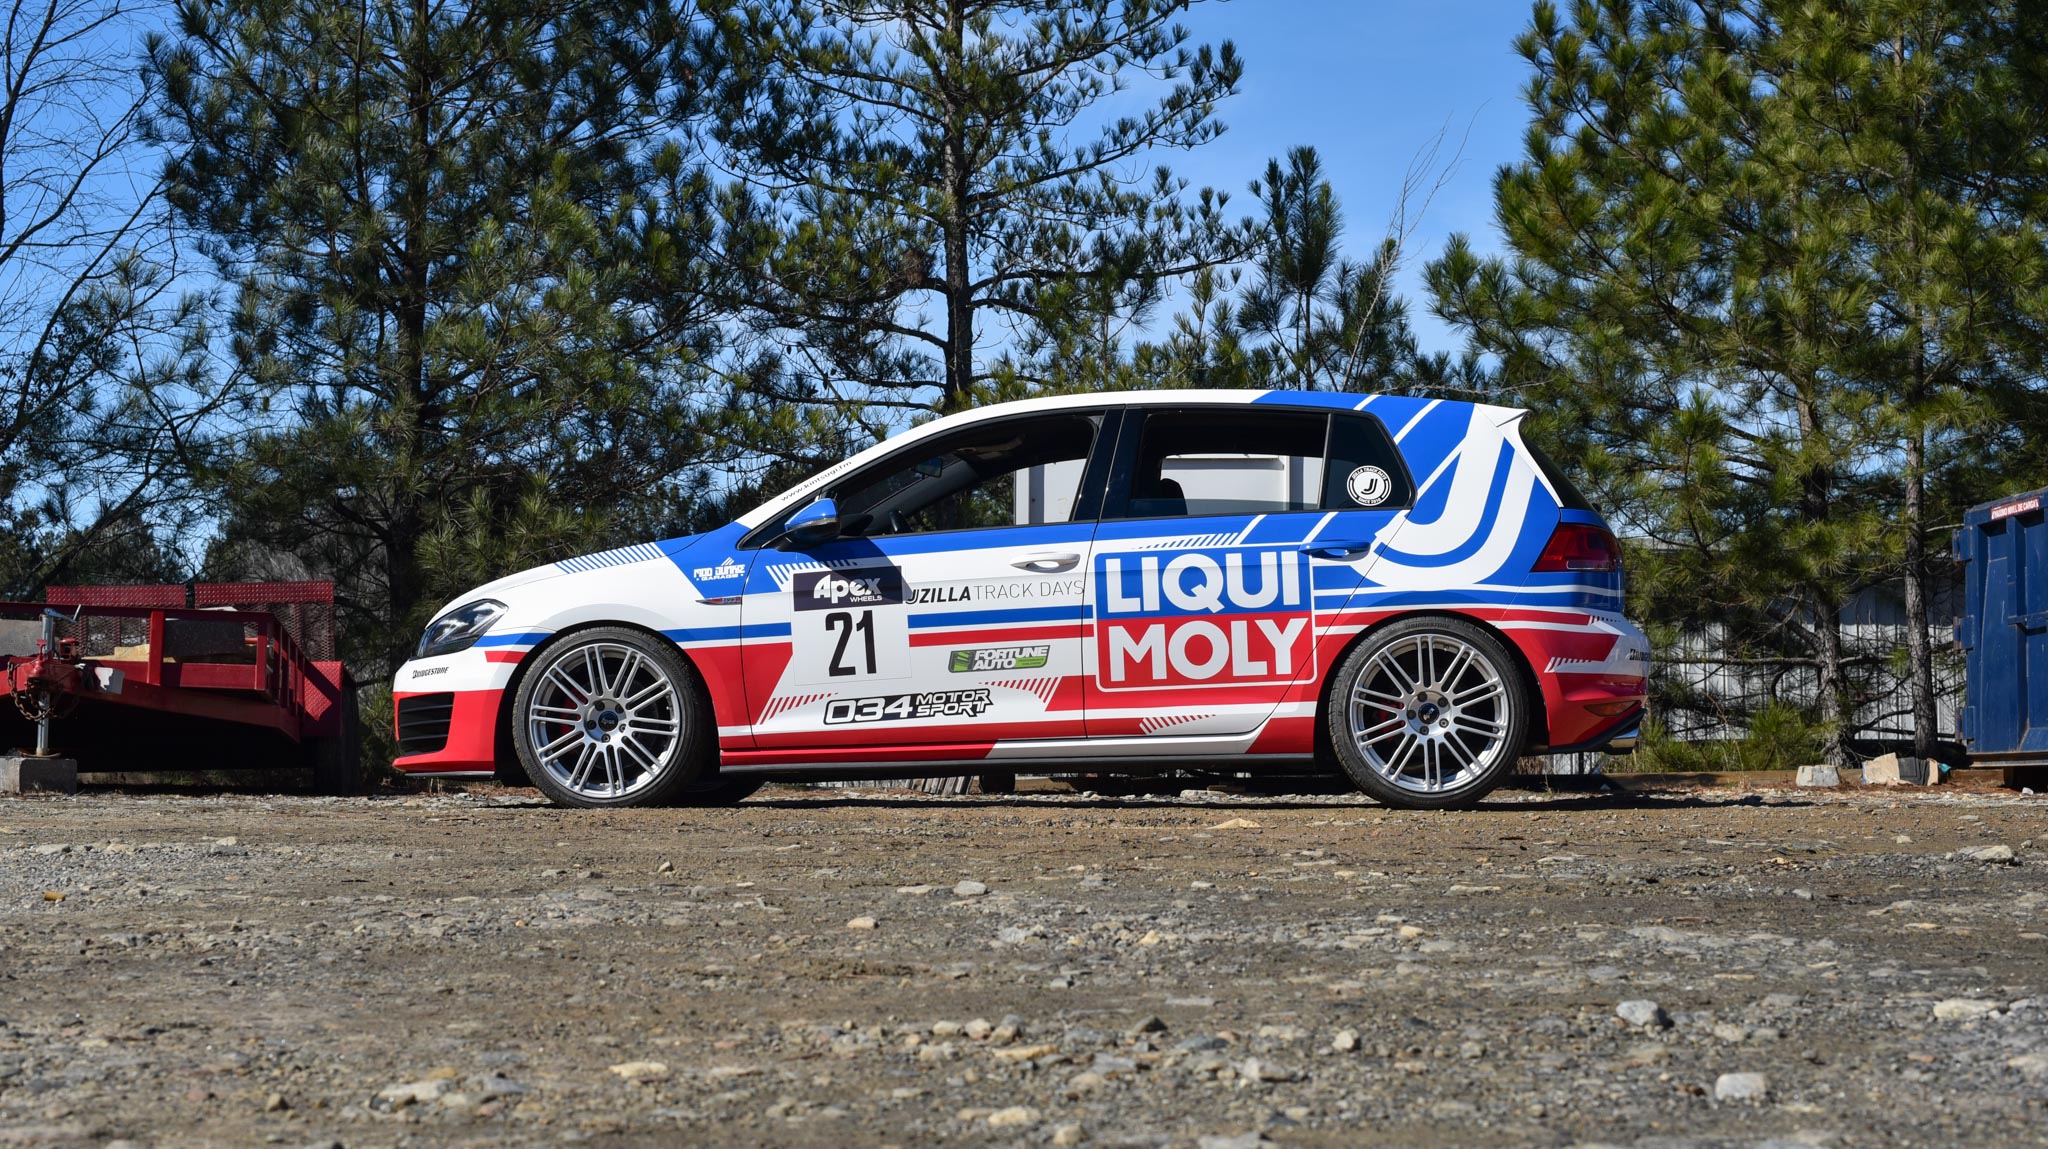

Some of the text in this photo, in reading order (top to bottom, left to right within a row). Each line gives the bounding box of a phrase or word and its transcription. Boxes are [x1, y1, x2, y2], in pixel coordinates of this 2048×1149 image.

[973, 582, 1034, 601] TRACK
[1040, 580, 1085, 597] DAYS
[1105, 550, 1301, 614] LIQUI
[850, 594, 882, 603] WHEELS
[825, 609, 877, 677] 21
[1108, 617, 1309, 682] MOLY
[974, 646, 1049, 661] FORTUNE
[972, 658, 1017, 671] AUTO
[916, 689, 989, 705] MOTOR
[825, 695, 913, 724] 034
[916, 701, 988, 717] SPORT
